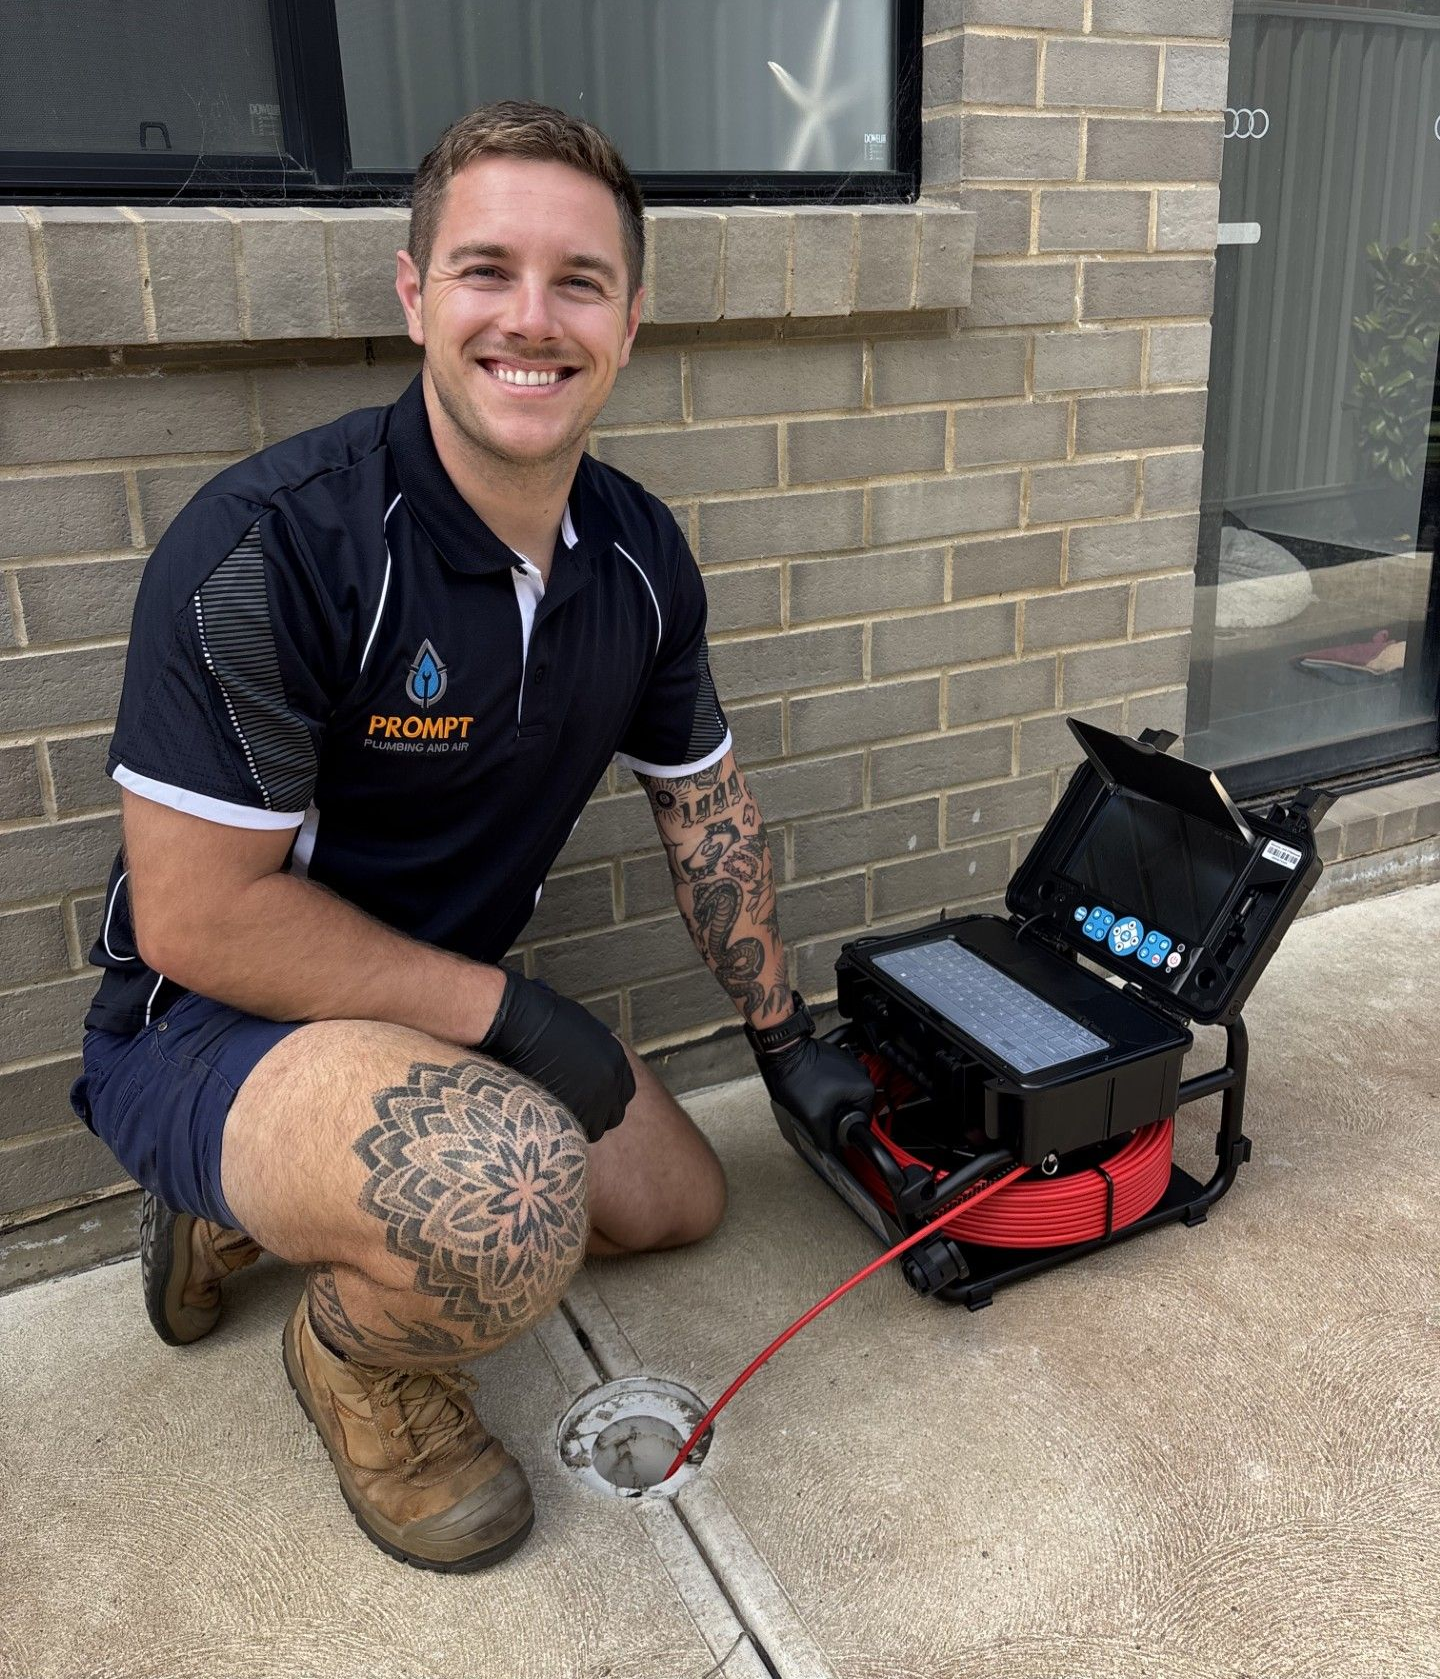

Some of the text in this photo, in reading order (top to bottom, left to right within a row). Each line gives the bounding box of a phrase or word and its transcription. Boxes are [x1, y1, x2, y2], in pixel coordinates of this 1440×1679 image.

[368, 715, 474, 739] PROMPT
[364, 739, 469, 753] PLUMBING AND AIR
[679, 770, 743, 828] 1999
